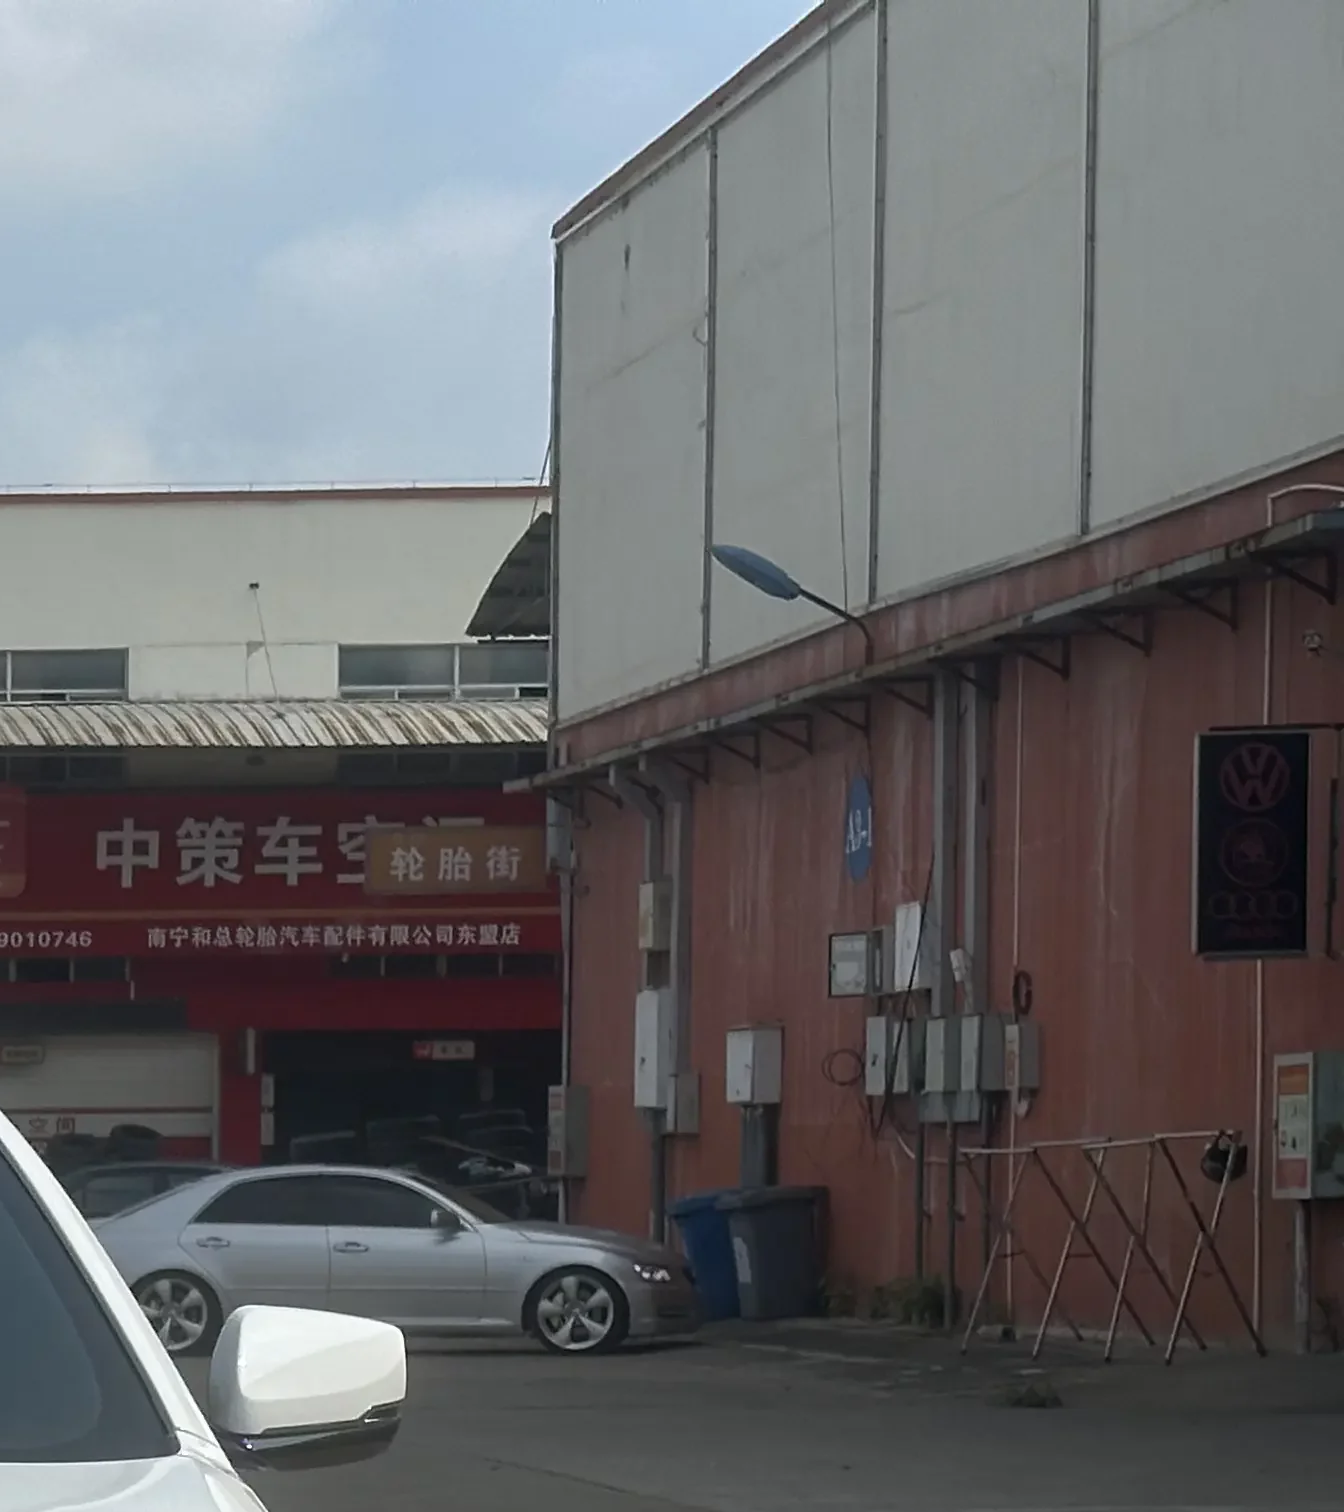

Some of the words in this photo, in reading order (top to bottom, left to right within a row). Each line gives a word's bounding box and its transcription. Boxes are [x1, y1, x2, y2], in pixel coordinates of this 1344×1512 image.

[95, 815, 485, 888] 中策车空
[389, 845, 522, 883] 轮胎街
